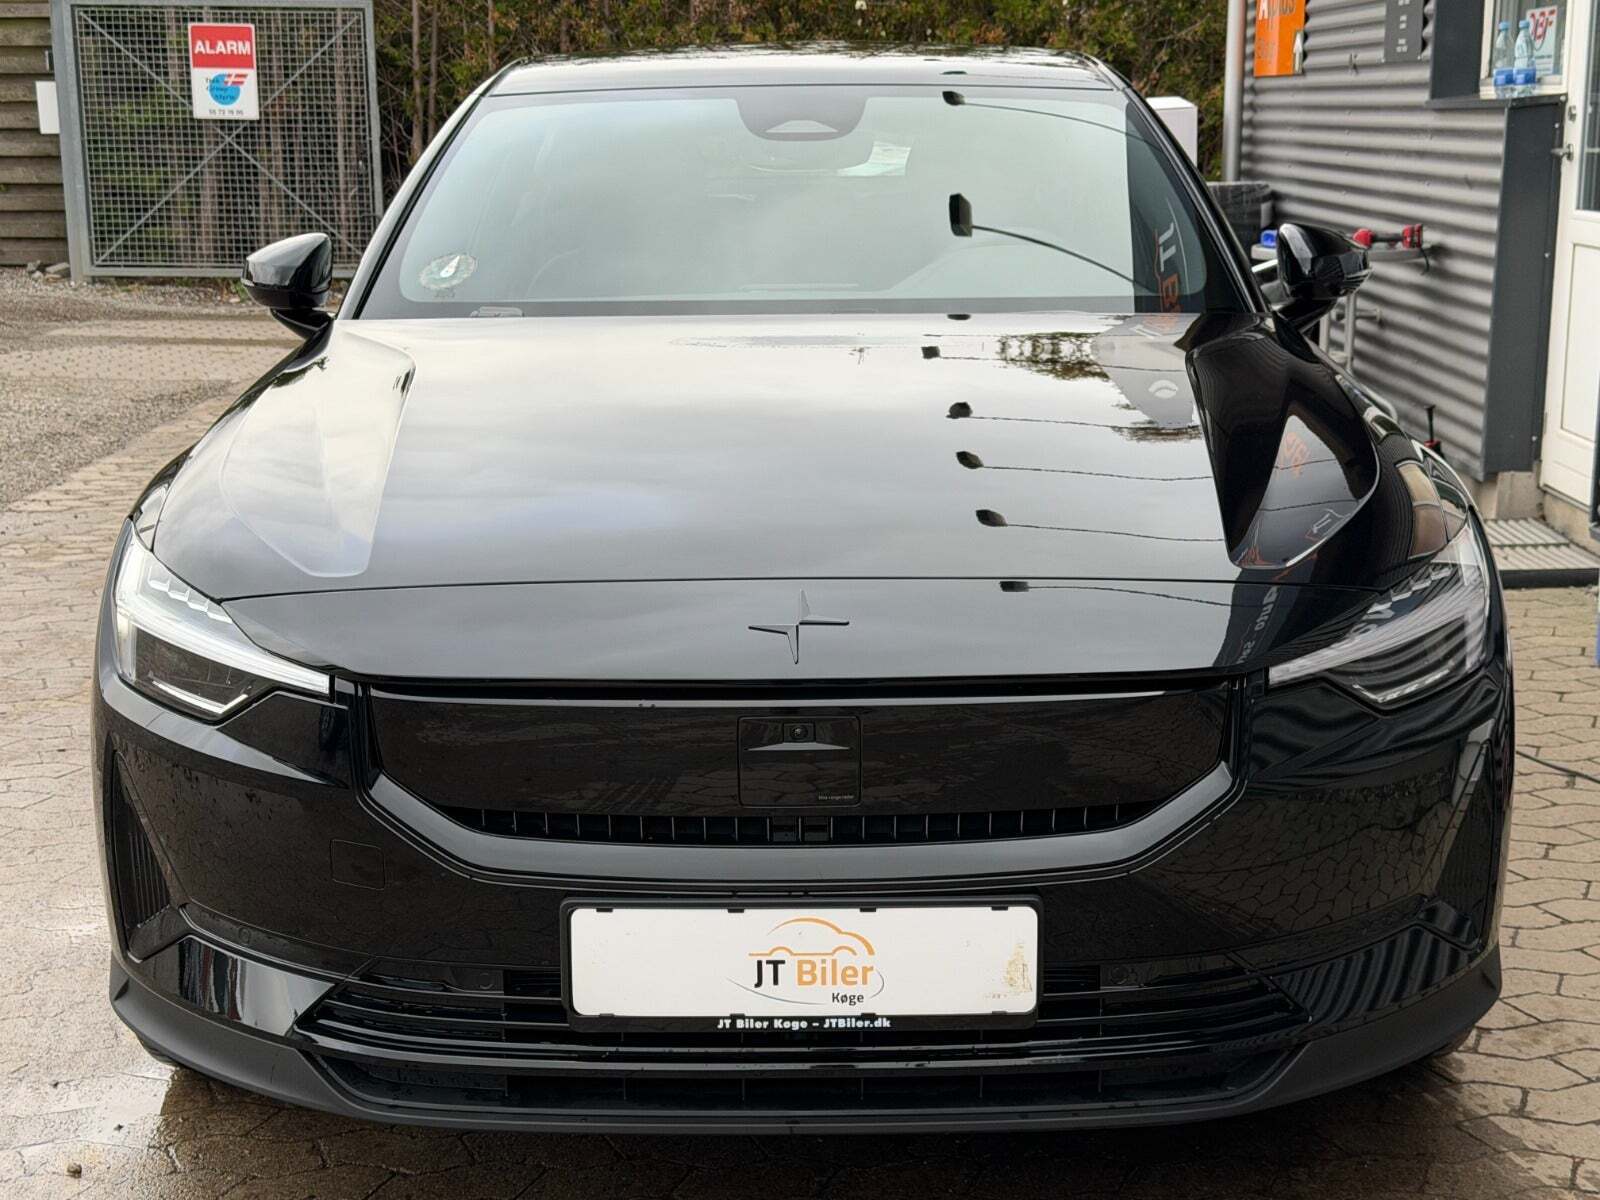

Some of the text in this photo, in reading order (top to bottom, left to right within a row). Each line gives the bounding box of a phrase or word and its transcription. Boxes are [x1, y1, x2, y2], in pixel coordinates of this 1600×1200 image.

[194, 40, 252, 56] ALARM
[754, 958, 874, 988] JT Biler
[831, 992, 865, 1006] Køge
[717, 1018, 732, 1029] JT
[736, 1018, 769, 1029] Biler
[823, 1017, 891, 1029] JTBiler.dk
